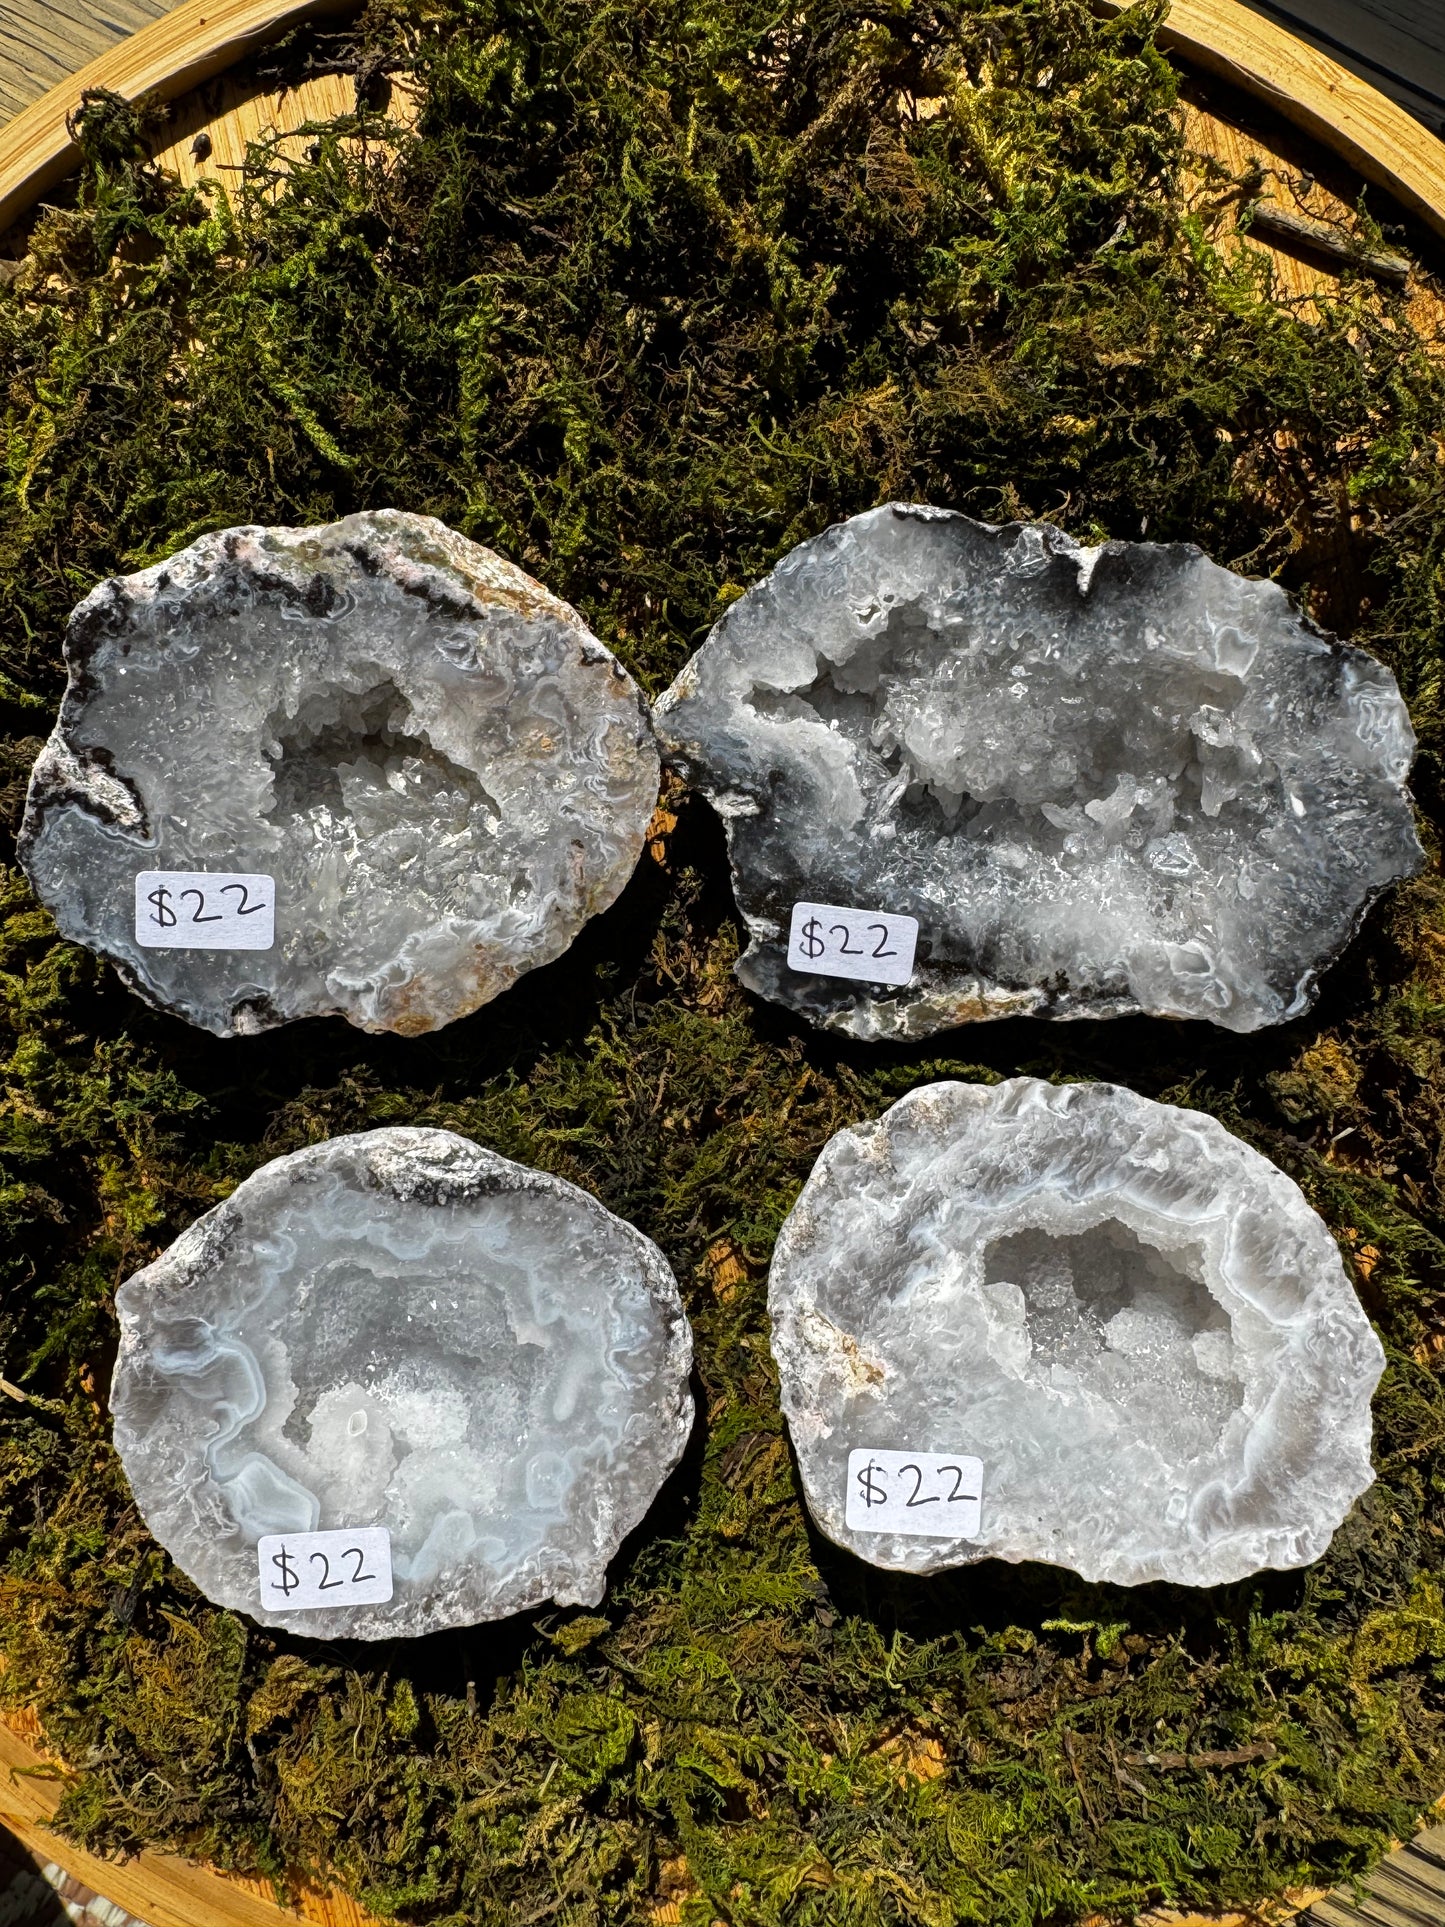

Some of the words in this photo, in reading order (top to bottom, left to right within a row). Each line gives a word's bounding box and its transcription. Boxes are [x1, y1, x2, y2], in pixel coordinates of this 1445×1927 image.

[147, 884, 266, 928] $22
[800, 917, 898, 960] $22
[856, 1458, 978, 1508] $22
[271, 1543, 376, 1597] $22
